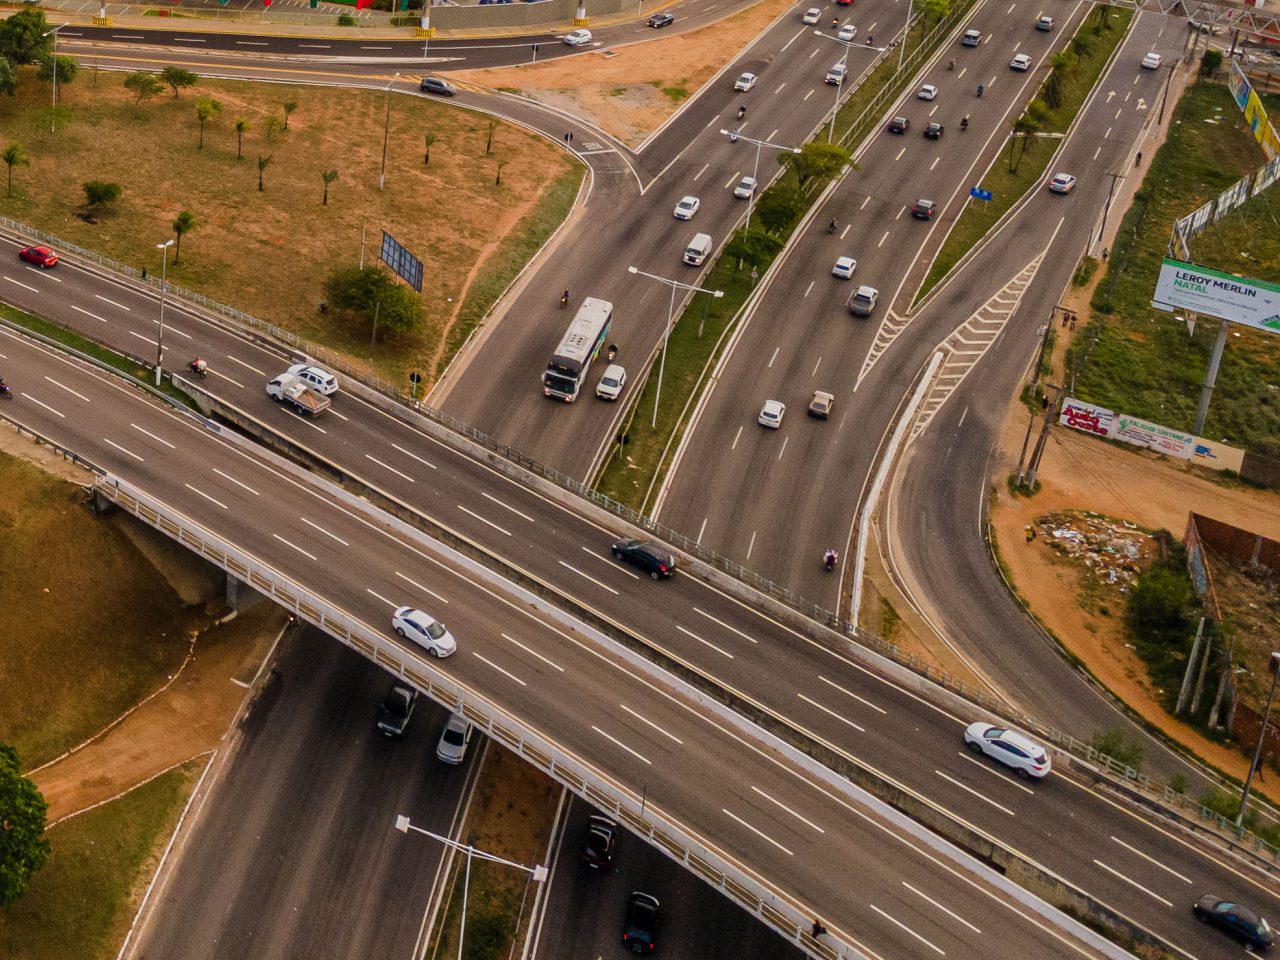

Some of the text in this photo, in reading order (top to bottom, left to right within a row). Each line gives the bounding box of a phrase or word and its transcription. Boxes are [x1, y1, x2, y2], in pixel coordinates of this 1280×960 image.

[1174, 279, 1208, 294] NATAL
[1176, 270, 1257, 298] LEROY MERLIN
